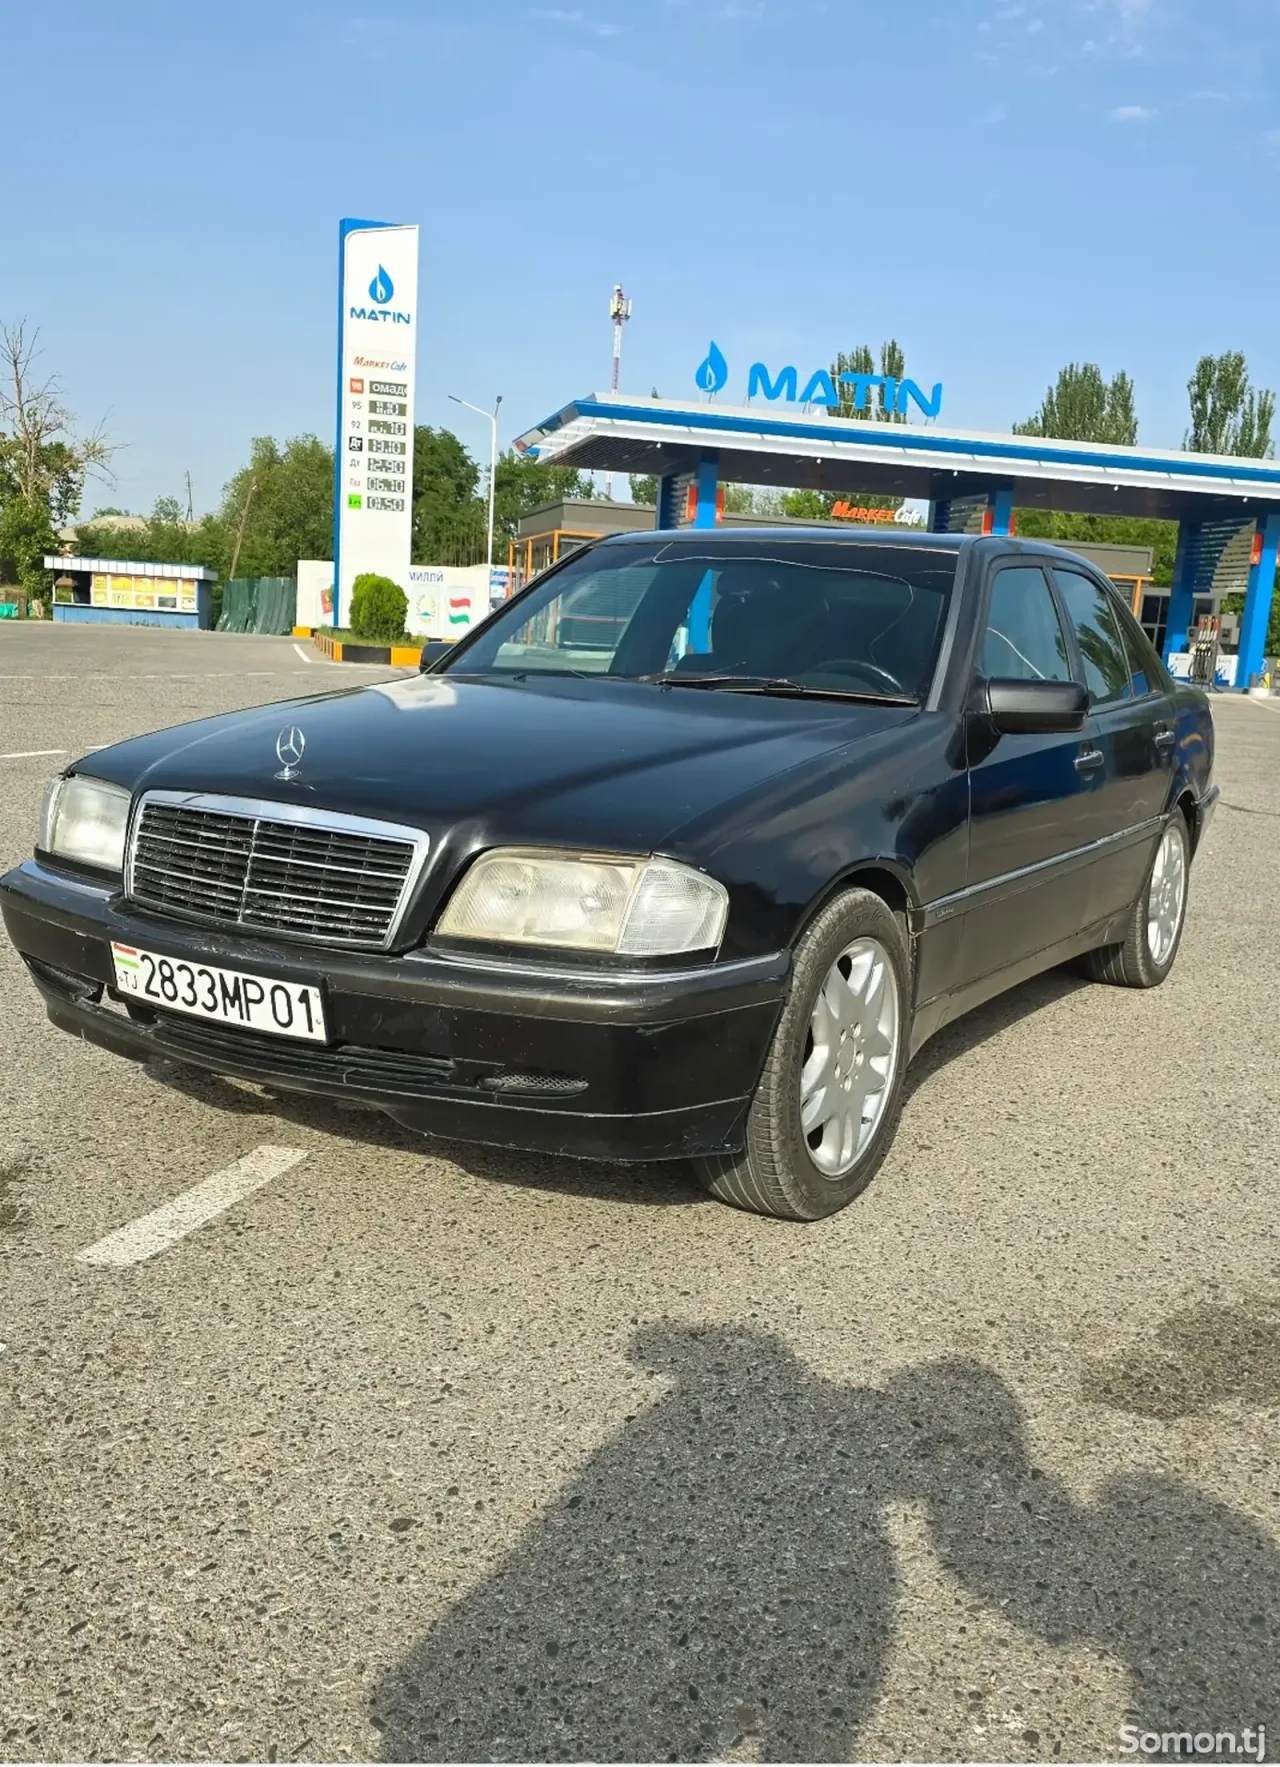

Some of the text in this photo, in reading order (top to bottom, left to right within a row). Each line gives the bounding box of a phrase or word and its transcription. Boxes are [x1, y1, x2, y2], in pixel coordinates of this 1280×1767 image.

[350, 307, 411, 325] MATIN
[748, 362, 943, 417] MATIN
[351, 401, 362, 410] 95
[350, 420, 361, 429] 92
[123, 970, 138, 990] TJ
[140, 954, 314, 1033] 2833MP01
